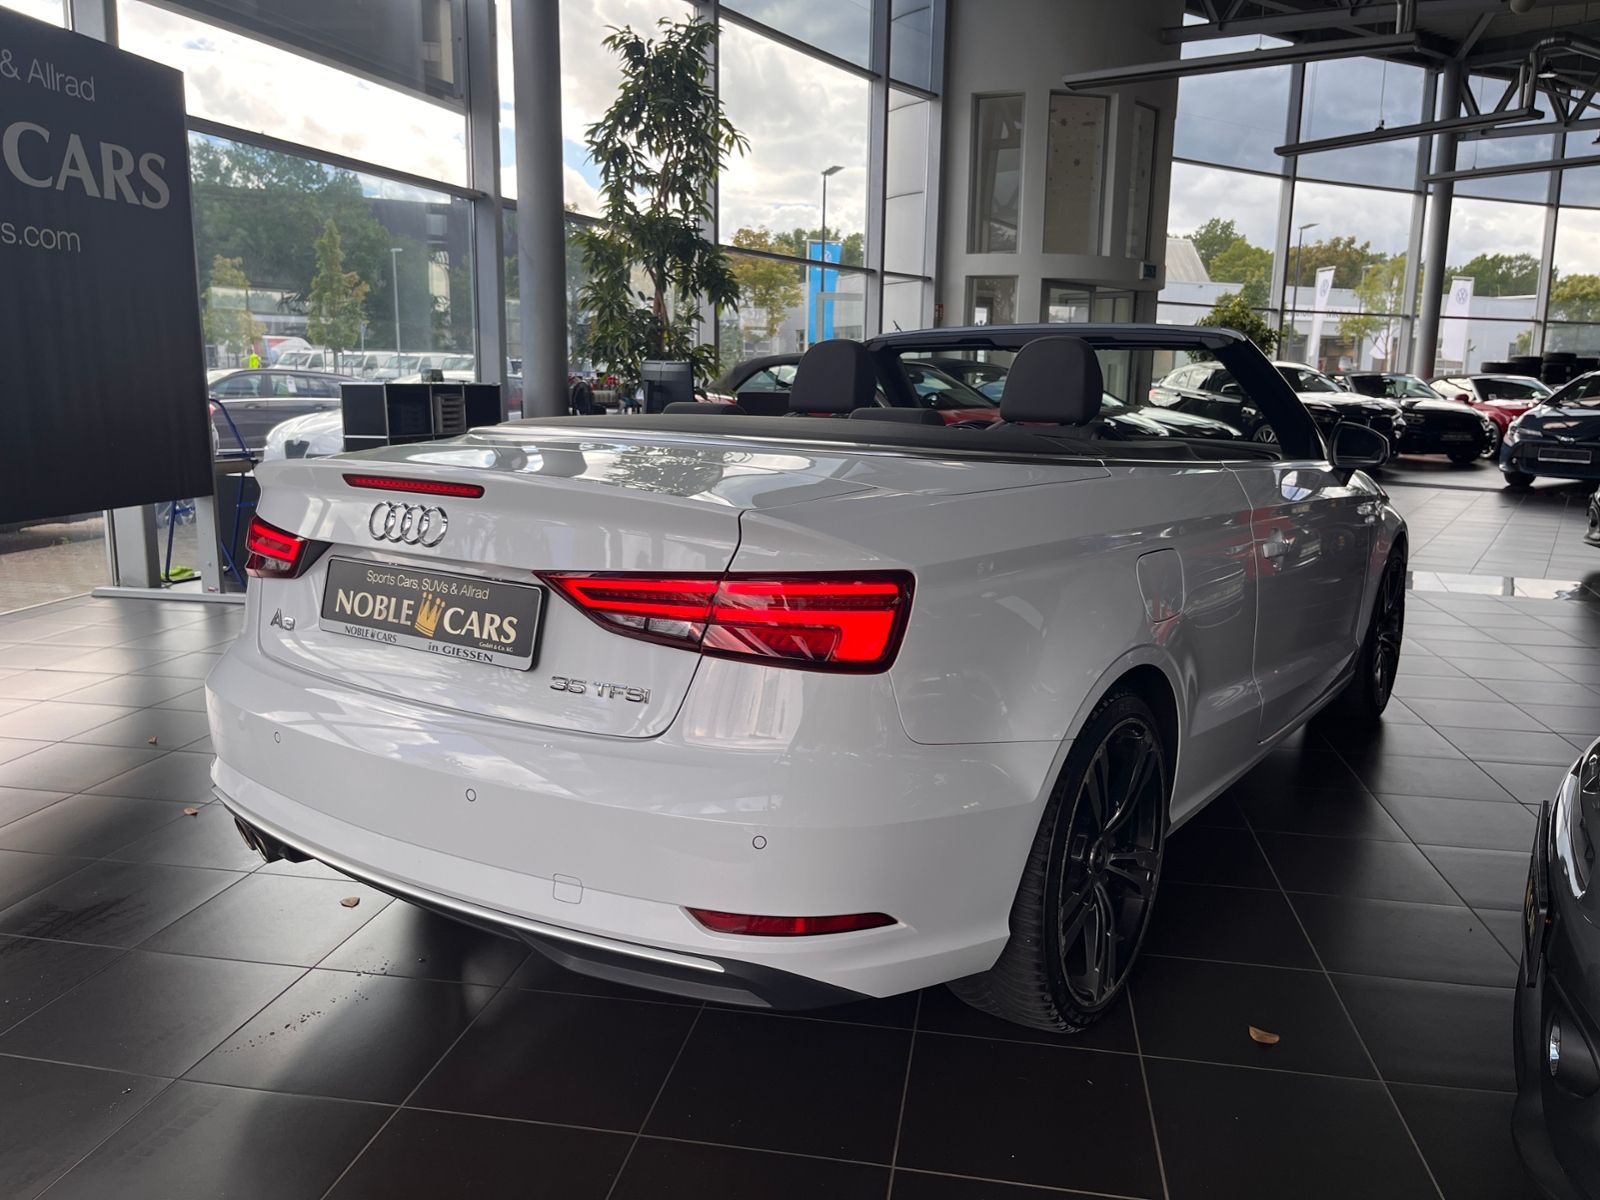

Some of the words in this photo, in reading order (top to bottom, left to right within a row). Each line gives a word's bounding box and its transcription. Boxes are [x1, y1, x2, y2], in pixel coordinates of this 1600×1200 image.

[0, 49, 21, 80] &
[27, 58, 95, 102] Allrad
[2, 121, 170, 210] CARS
[366, 569, 396, 585] Sports
[397, 574, 419, 590] Cars,
[421, 578, 449, 594] SUVs
[450, 582, 458, 595] &
[460, 584, 490, 600] Allrad
[270, 608, 295, 630] A3
[335, 588, 415, 626] NOBLE
[443, 607, 518, 644] CARS
[345, 625, 369, 640] NOBLE
[376, 631, 398, 643] CARS
[428, 642, 439, 652] in
[442, 645, 494, 663] GIESSEN
[550, 676, 587, 694] 35
[593, 682, 651, 704] TFSI
